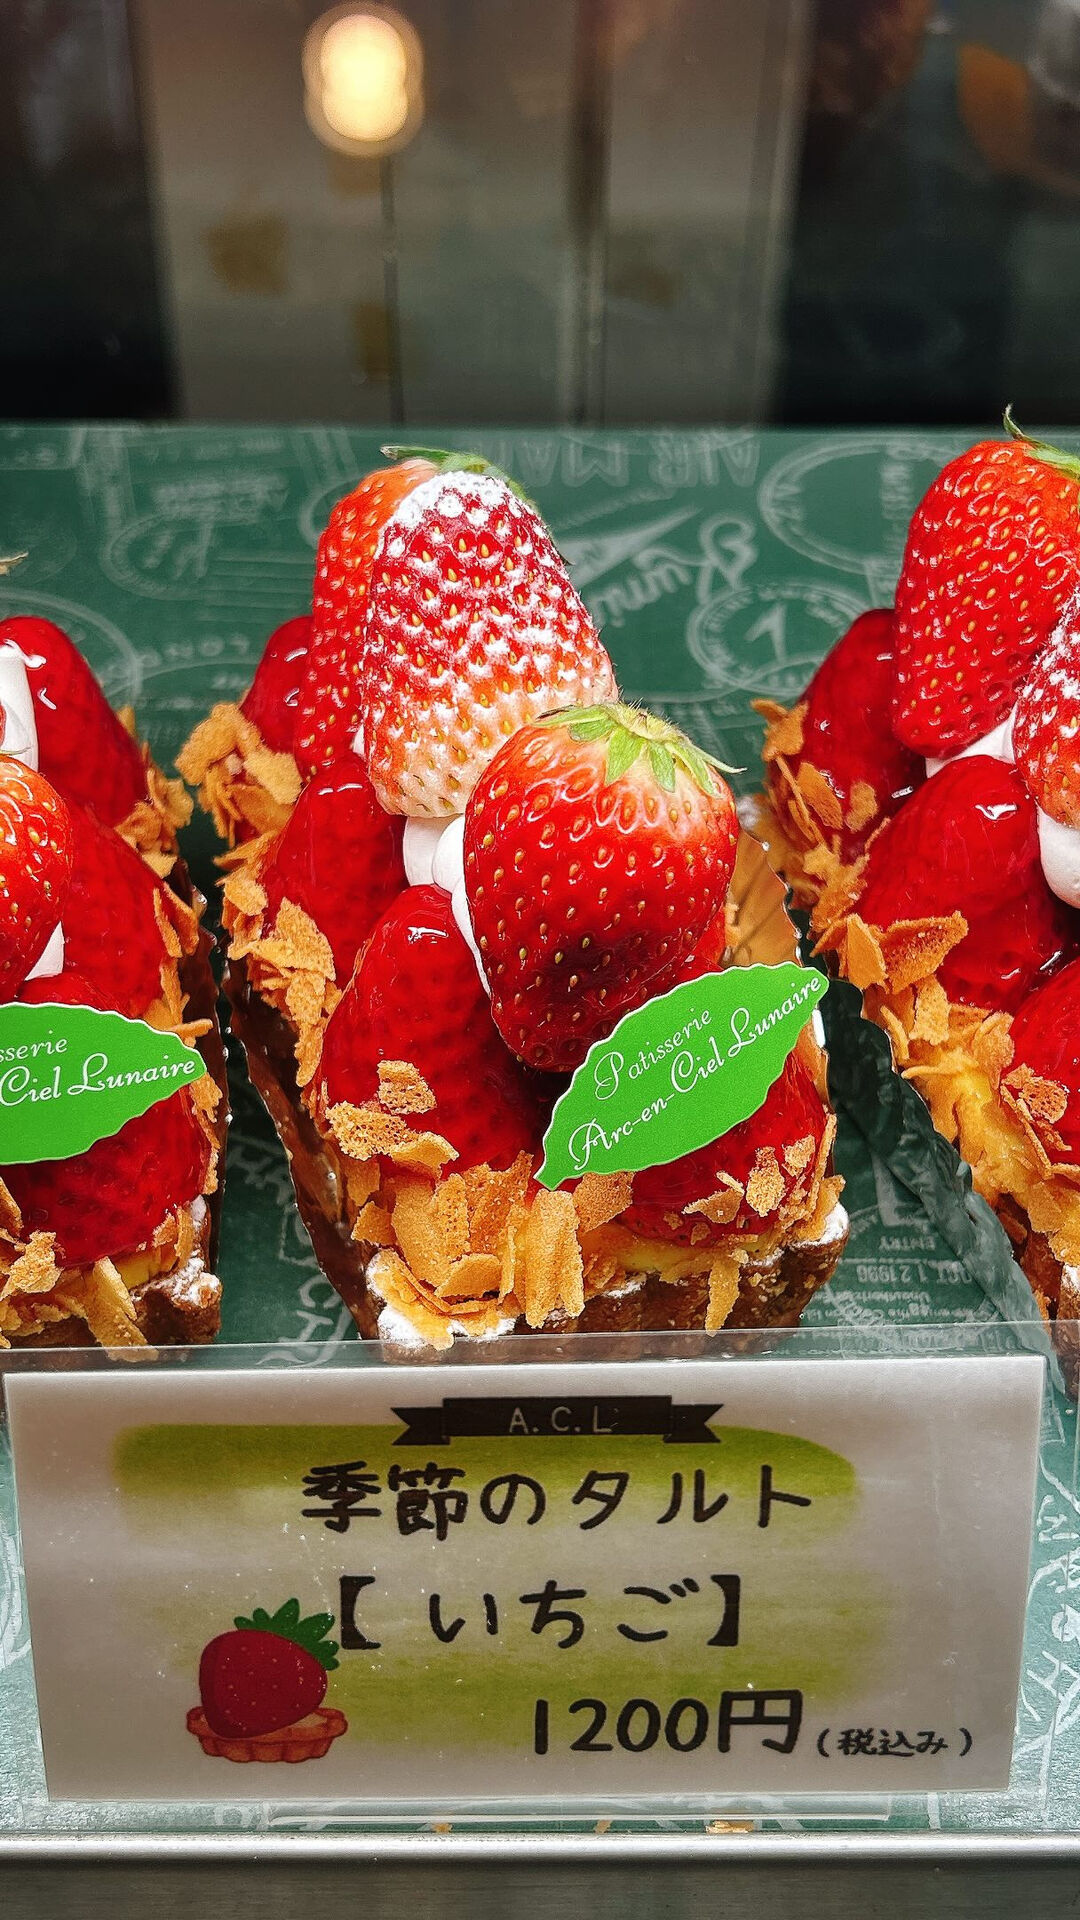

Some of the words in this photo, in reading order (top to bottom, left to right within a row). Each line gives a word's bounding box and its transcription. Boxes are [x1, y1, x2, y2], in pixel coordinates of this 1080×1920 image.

[649, 435, 761, 488] AIR
[0, 1066, 61, 1106] Ciel
[67, 1053, 196, 1095] Lunaire
[568, 1036, 725, 1171] Arc-en-Ciel
[727, 976, 821, 1058] Lunaire
[594, 1007, 712, 1100] Patisserie
[302, 1461, 812, 1540] 季節のタルト
[534, 1690, 804, 1754] 1200円
[816, 1727, 973, 1758] (税込み)
